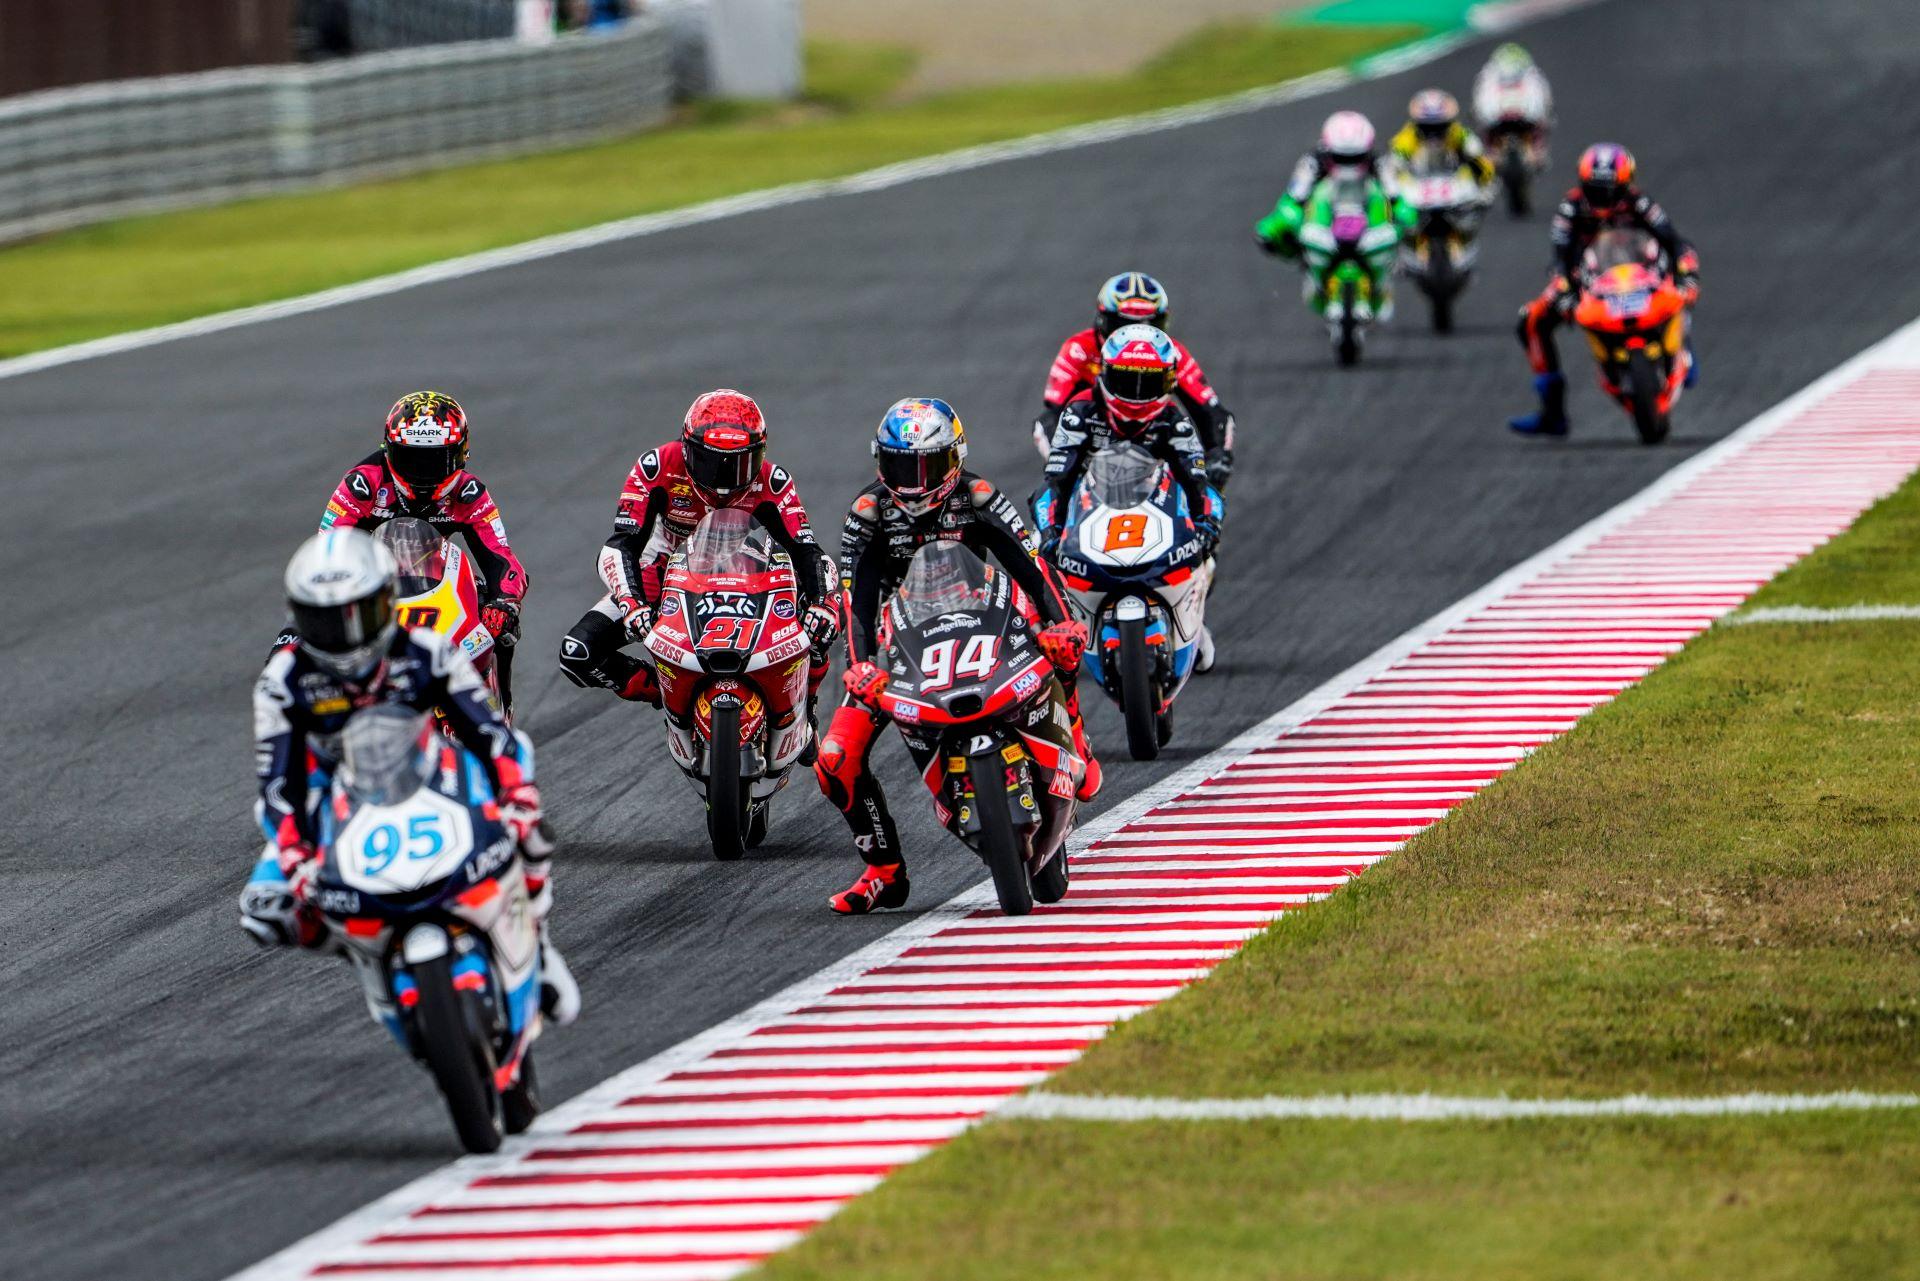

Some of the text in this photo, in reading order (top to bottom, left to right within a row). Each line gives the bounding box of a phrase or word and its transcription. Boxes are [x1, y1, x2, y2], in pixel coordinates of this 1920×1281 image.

[1121, 351, 1157, 360] SHARK
[708, 432, 747, 441] LS2
[371, 507, 395, 519] KTM
[1103, 513, 1149, 553] 8
[1058, 553, 1088, 576] LAZU
[1168, 538, 1201, 566] LAZU
[696, 616, 763, 650] 21
[922, 616, 982, 638] Landgeflügel
[651, 638, 685, 665] DENSSI
[765, 638, 803, 664] DENSSI
[920, 634, 1003, 697] 94
[1011, 671, 1038, 692] LIQUI
[1018, 680, 1041, 702] MOLY
[864, 797, 888, 849] DAINESE
[363, 814, 444, 877] 95
